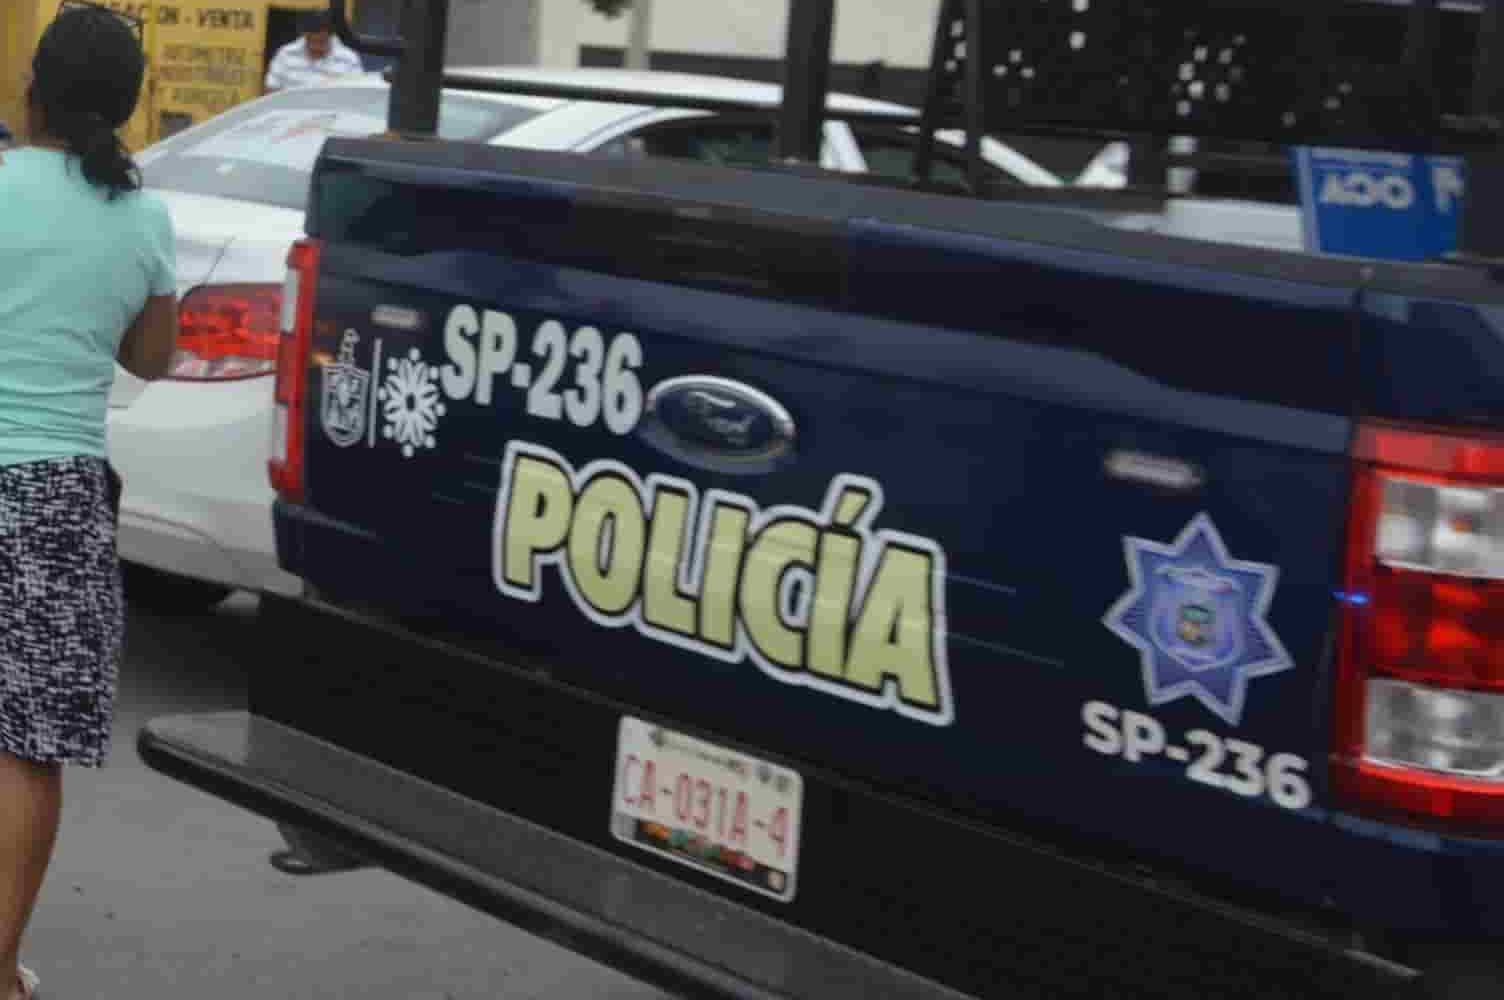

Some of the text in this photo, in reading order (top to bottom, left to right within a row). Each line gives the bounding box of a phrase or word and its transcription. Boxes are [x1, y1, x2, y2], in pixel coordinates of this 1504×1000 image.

[198, 8, 255, 31] VENTA
[440, 303, 644, 436] SP-236
[496, 443, 952, 724] POLICÍA
[1081, 699, 1314, 810] SP-236
